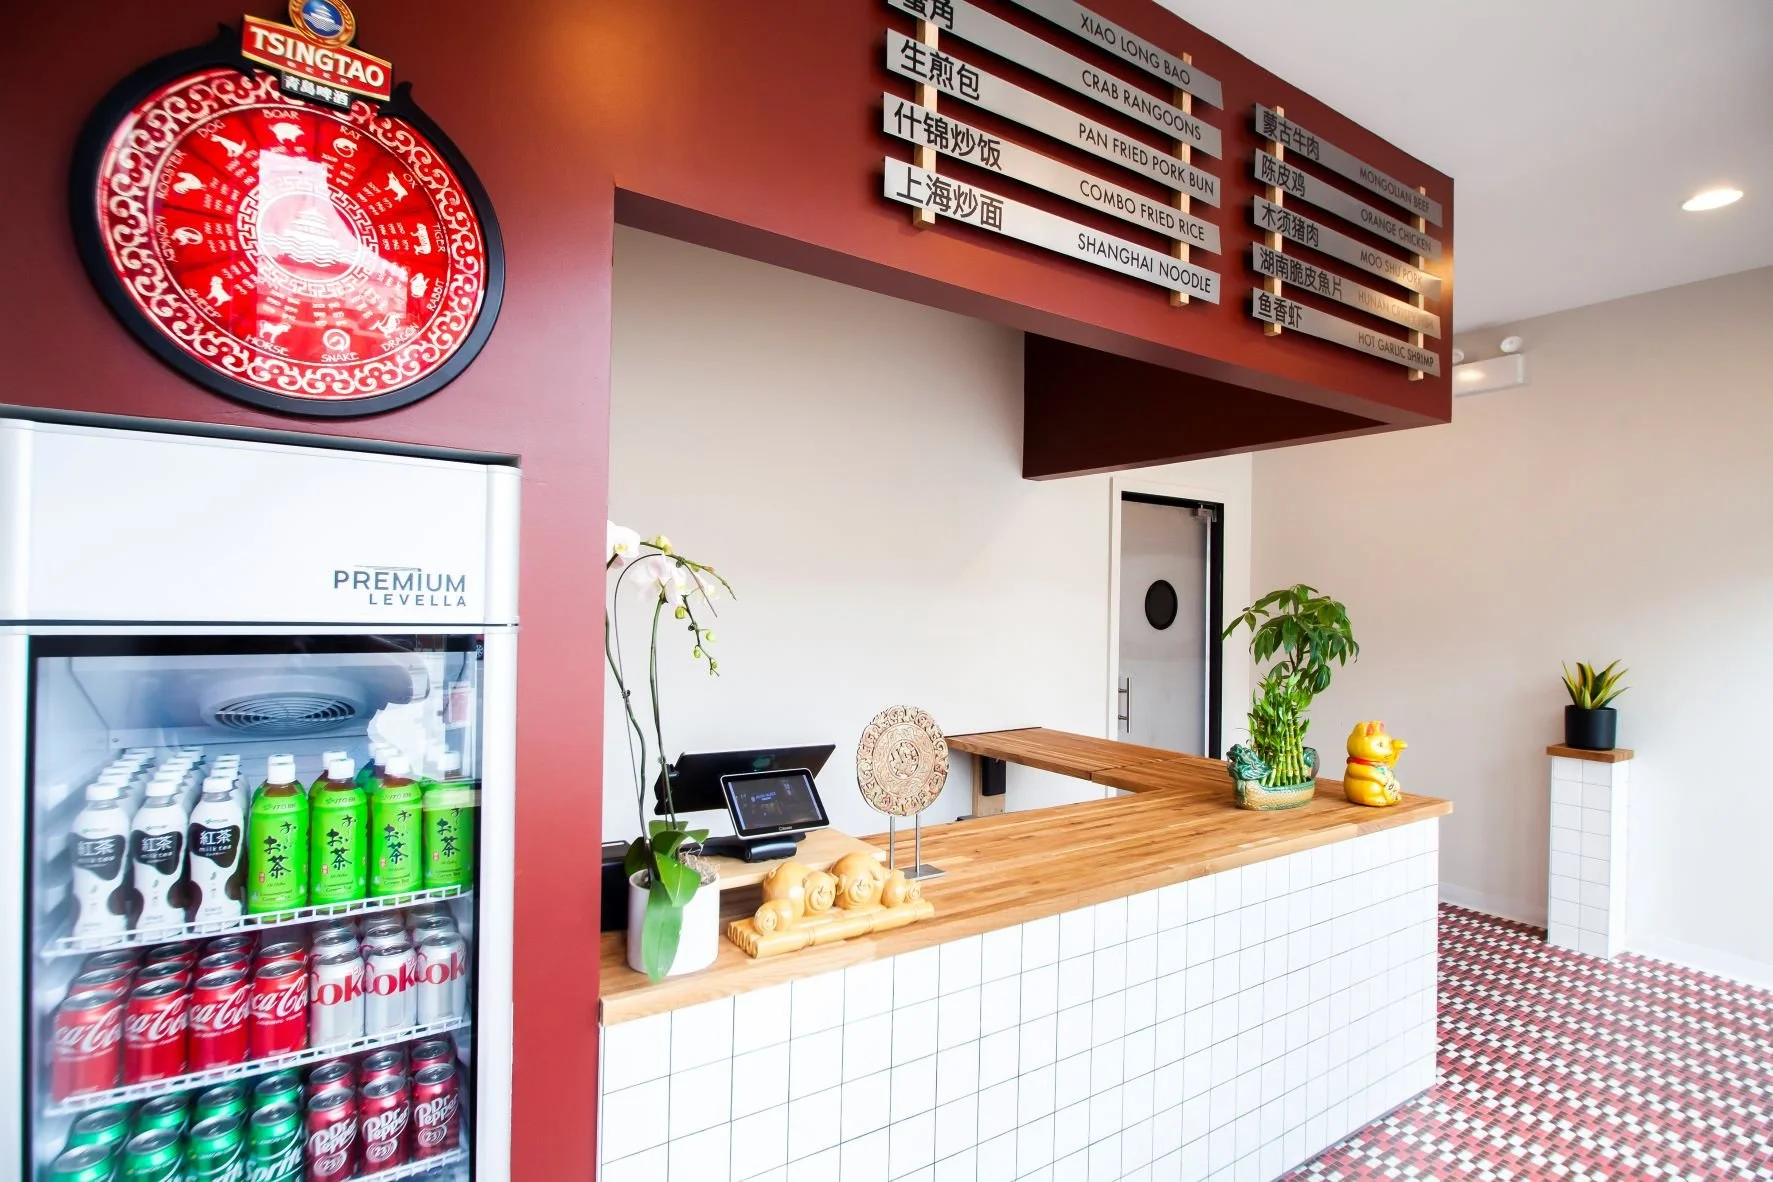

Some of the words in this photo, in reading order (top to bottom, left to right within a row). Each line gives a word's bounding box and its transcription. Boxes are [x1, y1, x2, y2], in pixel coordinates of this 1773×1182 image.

[250, 26, 384, 87] TSINGTAO
[1081, 13, 1116, 45] XIAO
[1121, 36, 1160, 69] LONG
[1164, 60, 1190, 85] BAO
[900, 39, 980, 101] 生煎包
[262, 109, 300, 121] BOAR
[1082, 70, 1119, 100] CRAB
[1124, 89, 1201, 141] RANGOONS
[196, 120, 225, 138] DOG
[340, 125, 362, 140] RAT
[894, 101, 1002, 171] 什锦炒饭
[1263, 110, 1320, 161] 蒙古牛肉
[1079, 123, 1107, 150] PAN
[1113, 138, 1148, 165] FRIED
[1152, 155, 1185, 183] PORK
[1189, 172, 1214, 196] BUN
[1261, 154, 1305, 197] 陈皮鸡
[896, 166, 1004, 231] 上海炒面
[1360, 167, 1412, 204] MONGOLIAN
[1413, 196, 1430, 213] BEEF
[1080, 180, 1136, 214] COMBO
[1141, 203, 1174, 229] FRIED
[1179, 218, 1205, 241] RICE
[1261, 202, 1319, 247] 木须猪肉
[156, 215, 178, 262] MONKEY
[433, 222, 446, 253] TIGER
[1360, 208, 1396, 237] ORANGE
[1398, 228, 1432, 252] CHICKEN
[1078, 233, 1153, 273] SHANGHAI
[1159, 260, 1211, 293] NOODLE
[1360, 251, 1383, 269] MOO
[1384, 260, 1400, 277] SHU
[1402, 270, 1423, 286] PORK
[426, 278, 444, 312] RABBIT
[1258, 291, 1303, 329] 鱼香虾
[1358, 290, 1389, 313] HUNAN
[381, 322, 419, 351] DRAGON
[1358, 331, 1375, 348] HOT
[1377, 338, 1406, 359] GARLIC
[1407, 349, 1434, 369] SHRIMP
[321, 352, 359, 363] SNAKE
[334, 570, 466, 592] PREMIUM
[369, 593, 466, 607] LEVELLA
[200, 829, 232, 845] 紅茶
[380, 1108, 399, 1124] Dr
[432, 1095, 448, 1111] Dr
[328, 1121, 347, 1137] Dr
